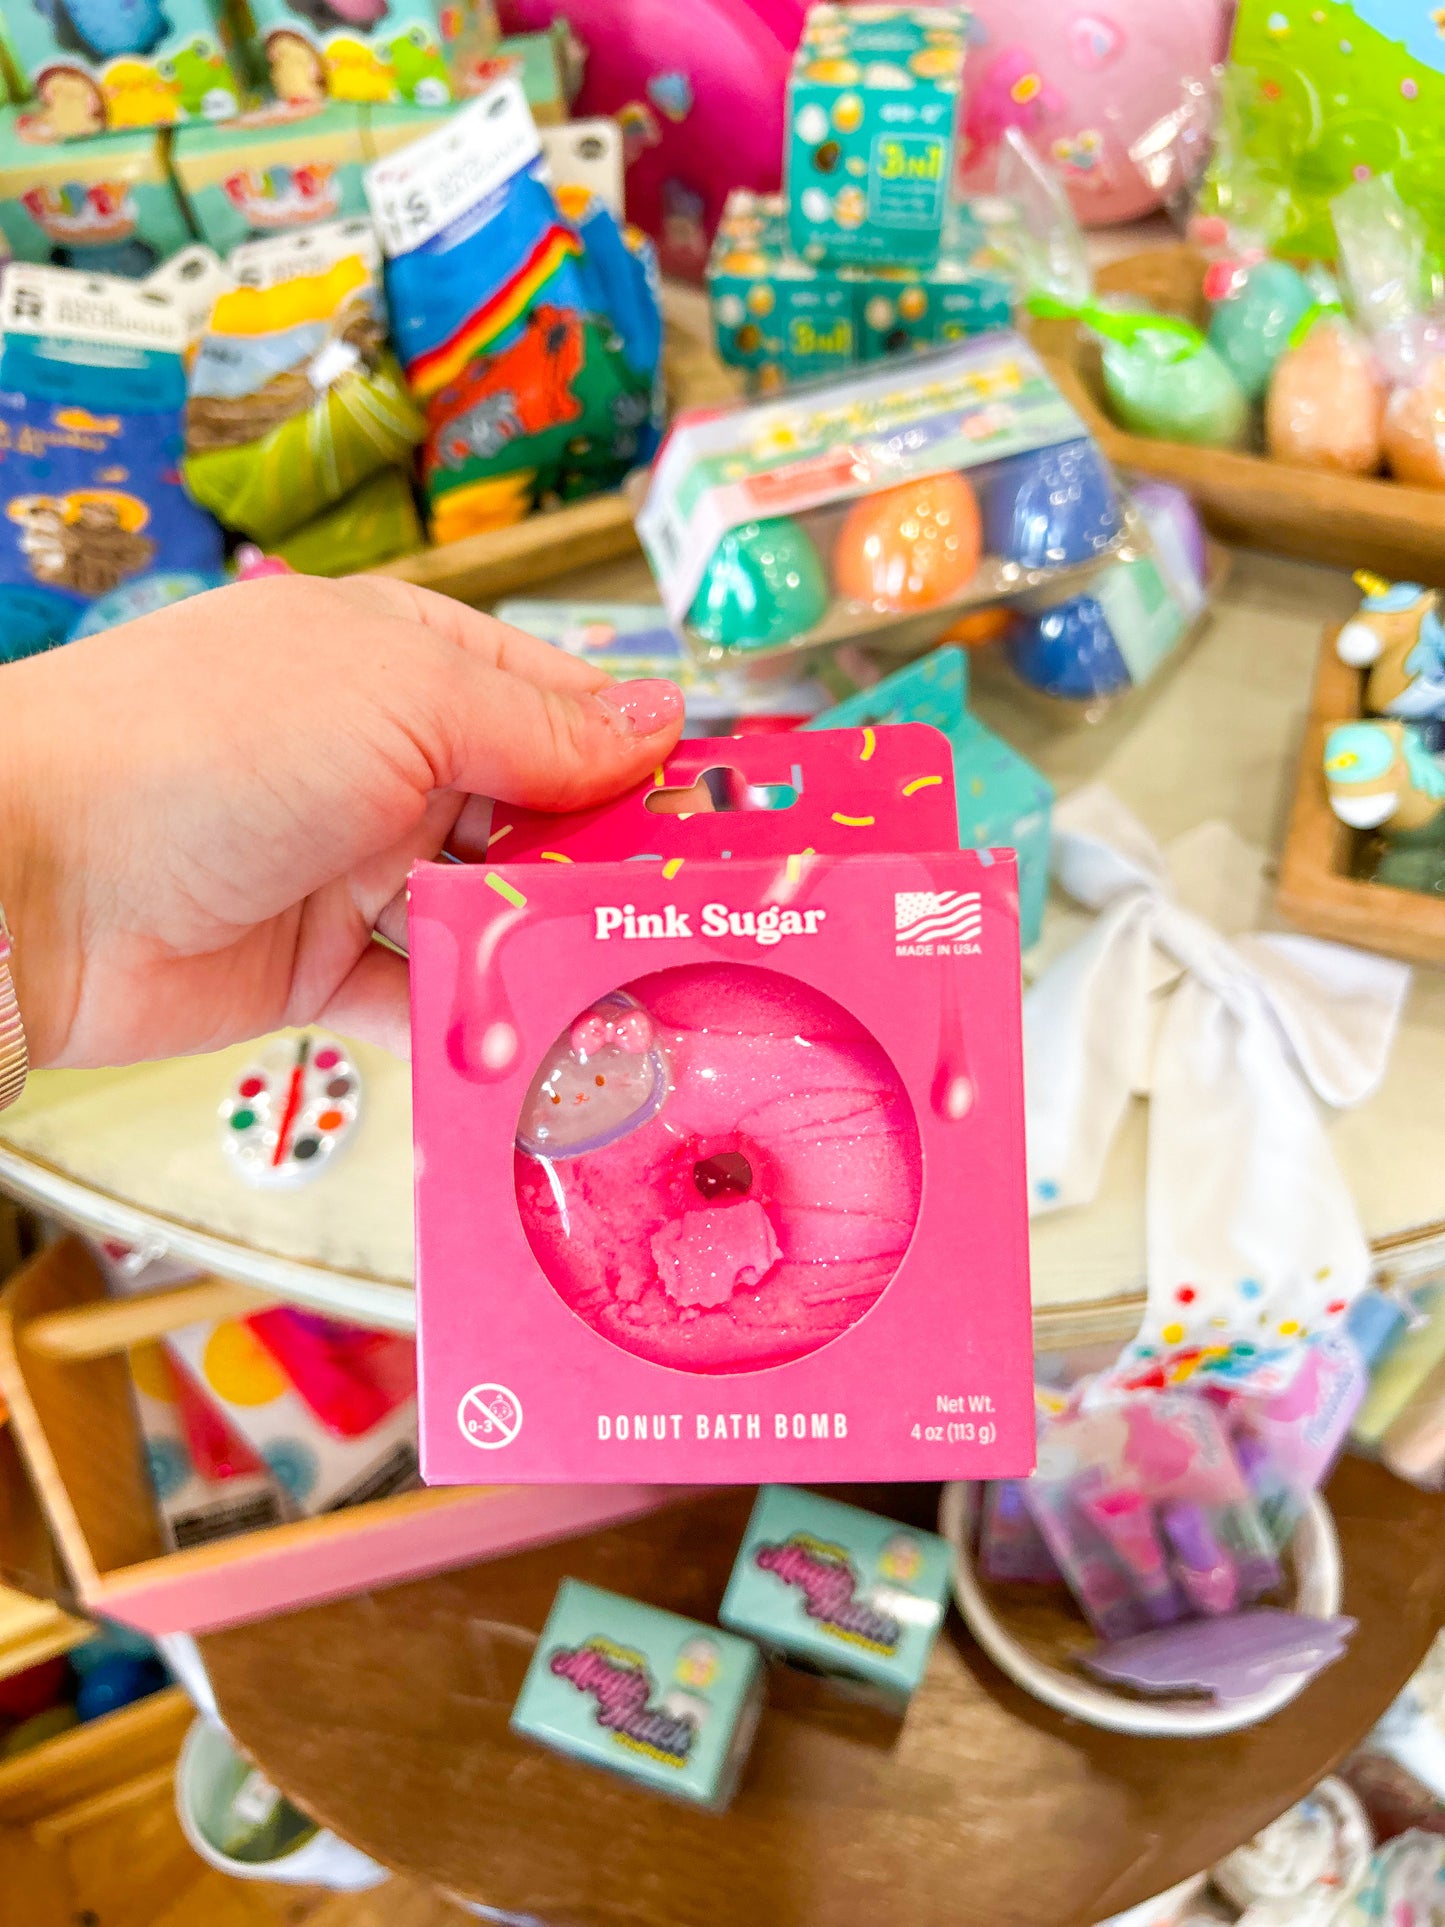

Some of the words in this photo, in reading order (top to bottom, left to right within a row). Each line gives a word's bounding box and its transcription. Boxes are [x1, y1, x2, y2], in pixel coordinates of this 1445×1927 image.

[594, 904, 693, 940] Pink
[700, 903, 826, 945] Sugar
[895, 945, 934, 957] MADE
[936, 944, 951, 956] IN
[953, 943, 982, 955] USA
[936, 1395, 965, 1413] Net
[967, 1395, 996, 1413] Wt.
[468, 1419, 493, 1433] 0-3
[597, 1415, 683, 1440] DONUT
[696, 1414, 760, 1439] BATH
[775, 1413, 848, 1439] BOMB
[910, 1423, 922, 1441] 4
[924, 1426, 944, 1441] oz
[946, 1422, 976, 1444] (113
[978, 1422, 997, 1446] g)
